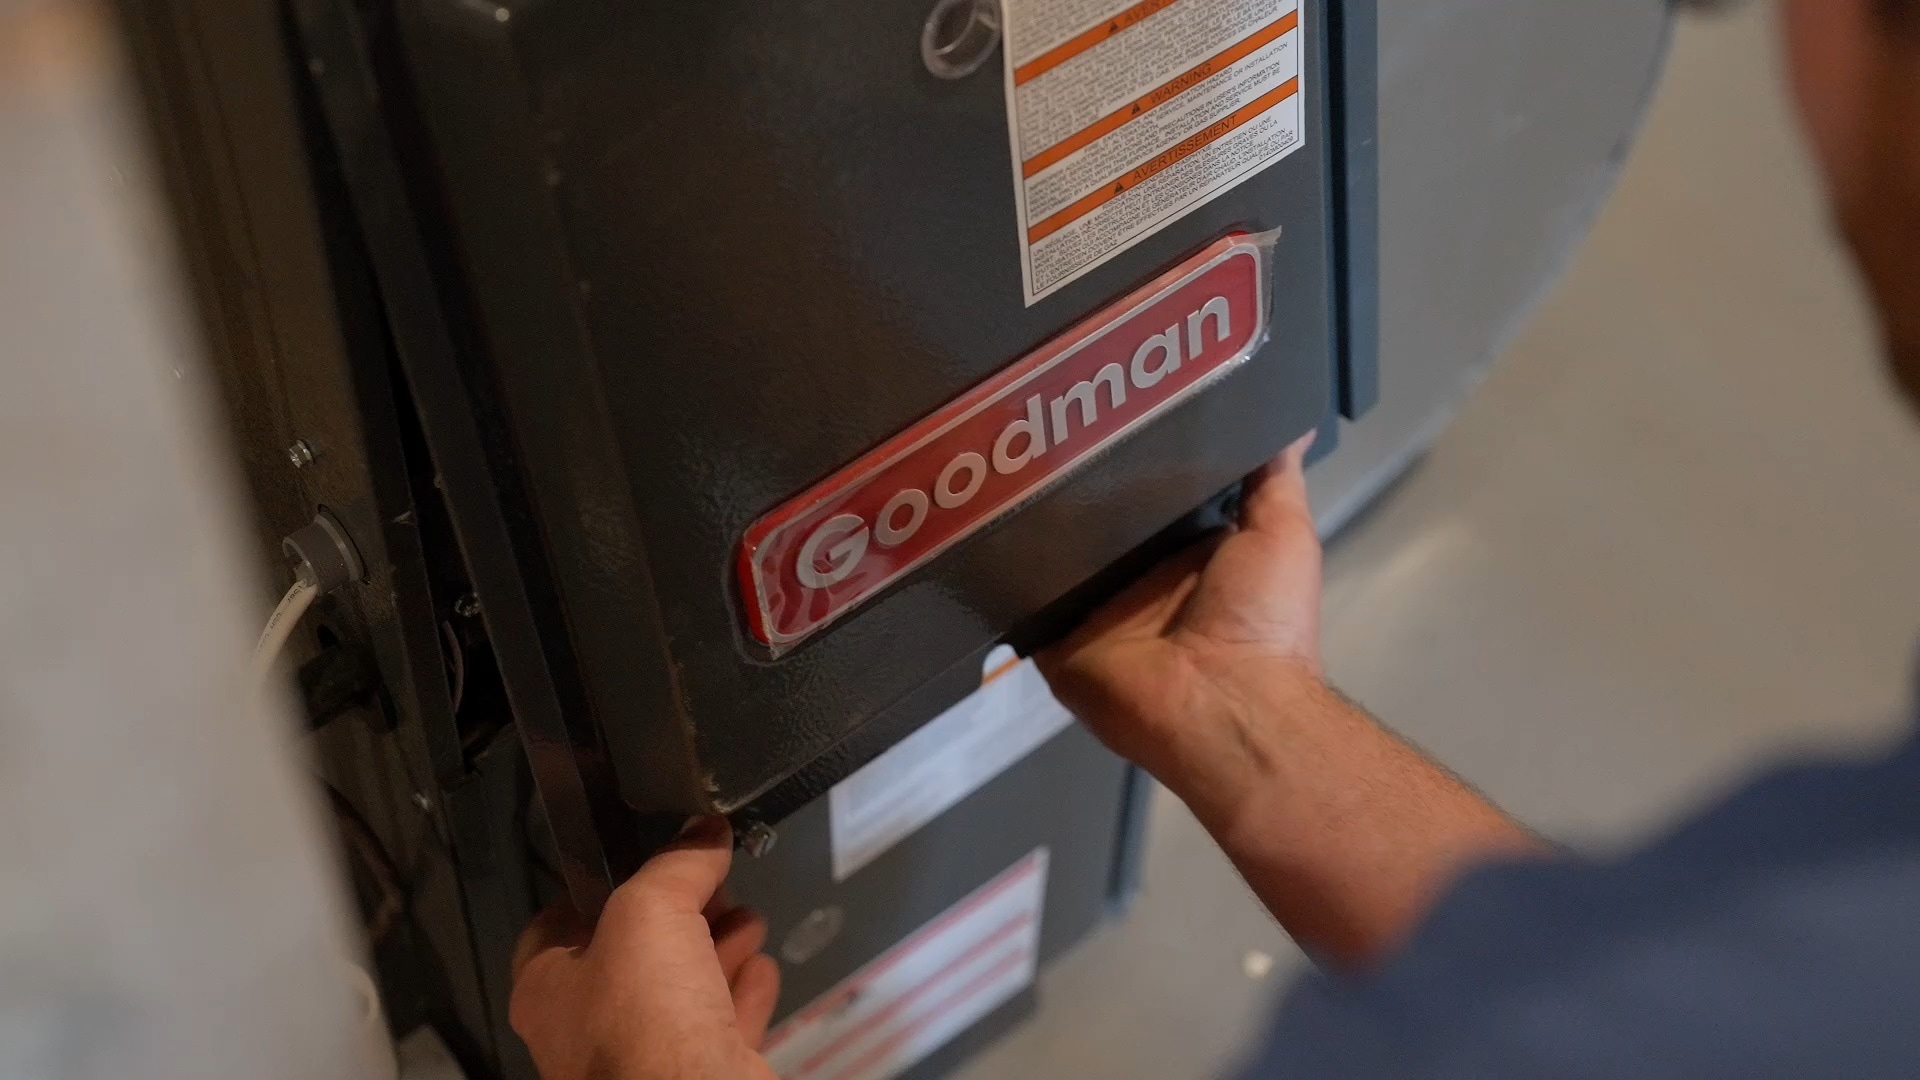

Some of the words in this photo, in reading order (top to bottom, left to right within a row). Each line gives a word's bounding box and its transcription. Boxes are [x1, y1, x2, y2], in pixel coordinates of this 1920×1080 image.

[1238, 23, 1246, 32] DE
[1150, 61, 1211, 105] WARNING
[1187, 73, 1232, 103] MAINTENANCE
[1234, 67, 1242, 77] OR
[1244, 41, 1287, 70] INSTALLATION
[1206, 66, 1232, 85] HAZARD
[1093, 139, 1142, 170] INSTRUCTIONS
[1144, 130, 1157, 142] AND
[1158, 103, 1204, 134] PRECAUTIONS
[1206, 99, 1212, 107] IN
[1237, 60, 1279, 89] INFORMATION
[1094, 163, 1111, 177] WITH
[1113, 154, 1127, 166] THIS
[1165, 107, 1209, 137] INSTALLATION
[1210, 99, 1223, 111] AND
[1225, 83, 1251, 102] SERVICE
[1254, 72, 1270, 86] MUST
[1272, 66, 1280, 76] BE
[1125, 136, 1134, 146] OR
[1126, 147, 1152, 166] SERVICE
[1156, 131, 1180, 150] AGENCY
[1183, 124, 1192, 134] OR
[1194, 115, 1207, 128] GAS
[1132, 114, 1237, 182] AVERTISSEMENT
[1102, 192, 1126, 211] RISQUE
[1165, 166, 1172, 174] ET
[1144, 182, 1156, 193] UNE
[1202, 151, 1210, 160] UN
[1212, 130, 1246, 154] ENTRETIEN
[1248, 124, 1257, 133] OU
[1258, 116, 1271, 127] UNE
[1034, 233, 1080, 264] INSTALLATION
[1124, 198, 1140, 212] PEUT
[1180, 168, 1192, 179] DES
[1195, 146, 1231, 171] BLESSURES
[1233, 130, 1257, 149] GRAVES
[1259, 124, 1268, 134] OU
[1270, 119, 1277, 127] LA
[1036, 275, 1043, 284] ET
[1088, 232, 1116, 253] DOIVENT
[1174, 191, 1187, 203] PAR
[1188, 185, 1197, 195] UN
[1270, 137, 1279, 147] OU
[1280, 130, 1292, 141] PAR
[1082, 239, 1093, 250] QUI
[1095, 212, 1140, 242] ACCOMPAGNE
[1142, 206, 1150, 215] CE
[1196, 170, 1212, 183] D'AIR
[1083, 231, 1095, 242] LES
[1141, 200, 1149, 208] ET
[1151, 192, 1163, 203] LES
[1164, 169, 1202, 195] CONSIGNES
[1203, 158, 1220, 173] DANS
[1222, 153, 1229, 162] LA
[1231, 140, 1253, 157] NOTICE
[1036, 281, 1044, 290] LE
[1046, 253, 1092, 284] FOURNISSEUR
[1093, 247, 1102, 257] DE
[1104, 239, 1117, 251] GAZ
[797, 294, 1230, 589] Goodman
